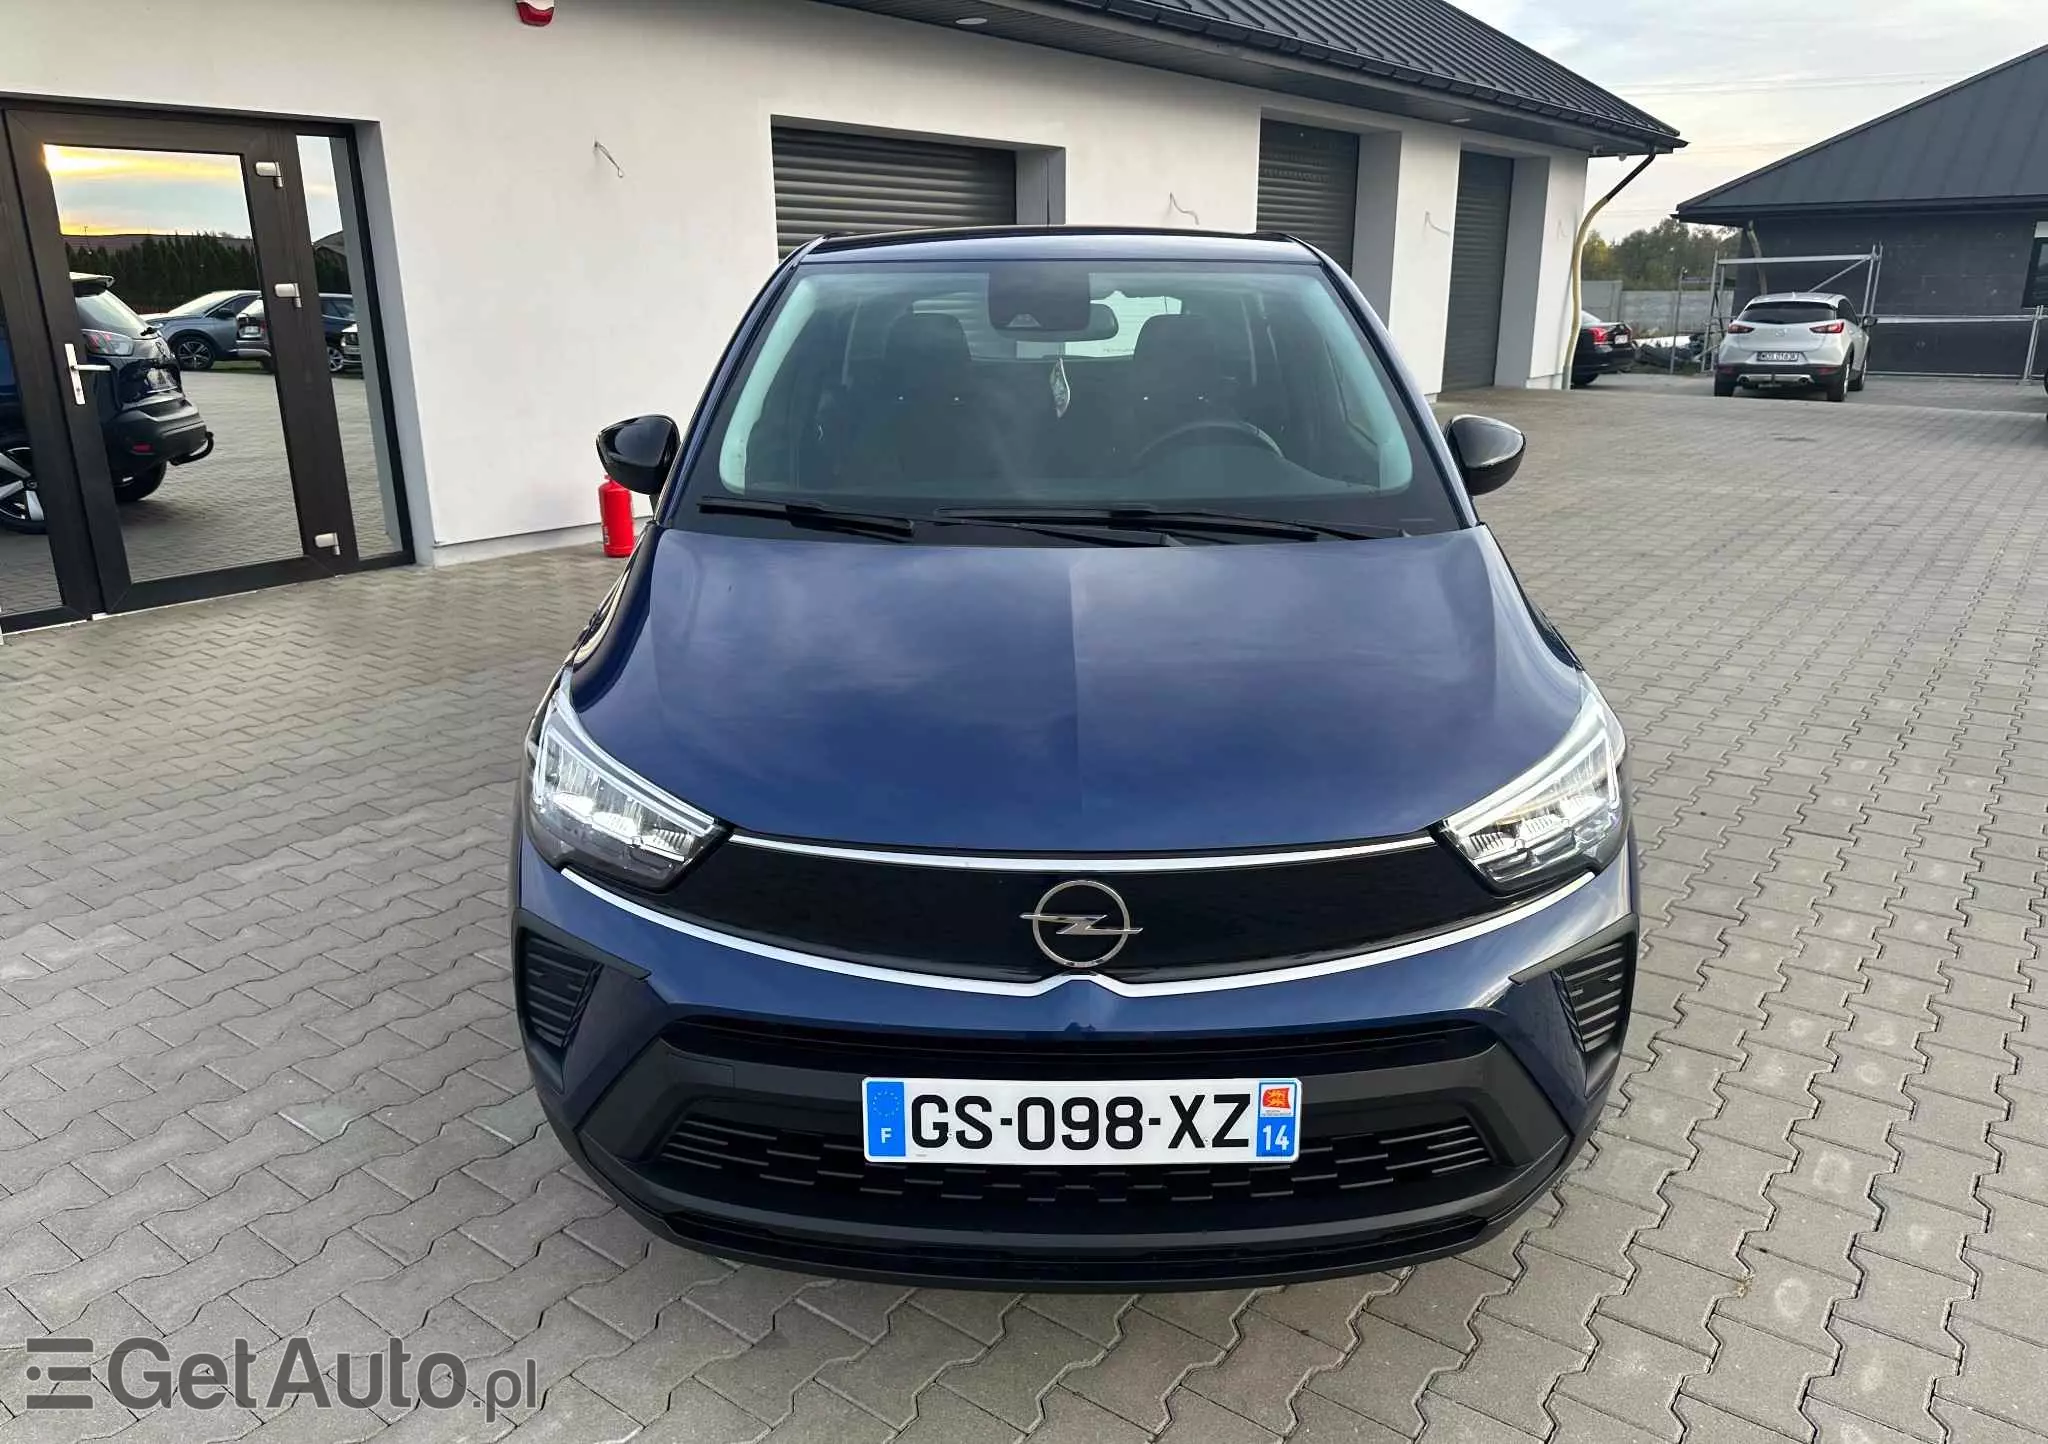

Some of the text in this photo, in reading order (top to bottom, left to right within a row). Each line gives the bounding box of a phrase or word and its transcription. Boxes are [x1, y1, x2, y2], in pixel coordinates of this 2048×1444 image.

[880, 1127, 893, 1144] F
[911, 1093, 1251, 1151] GS-098-XZ
[1262, 1124, 1290, 1151] 14
